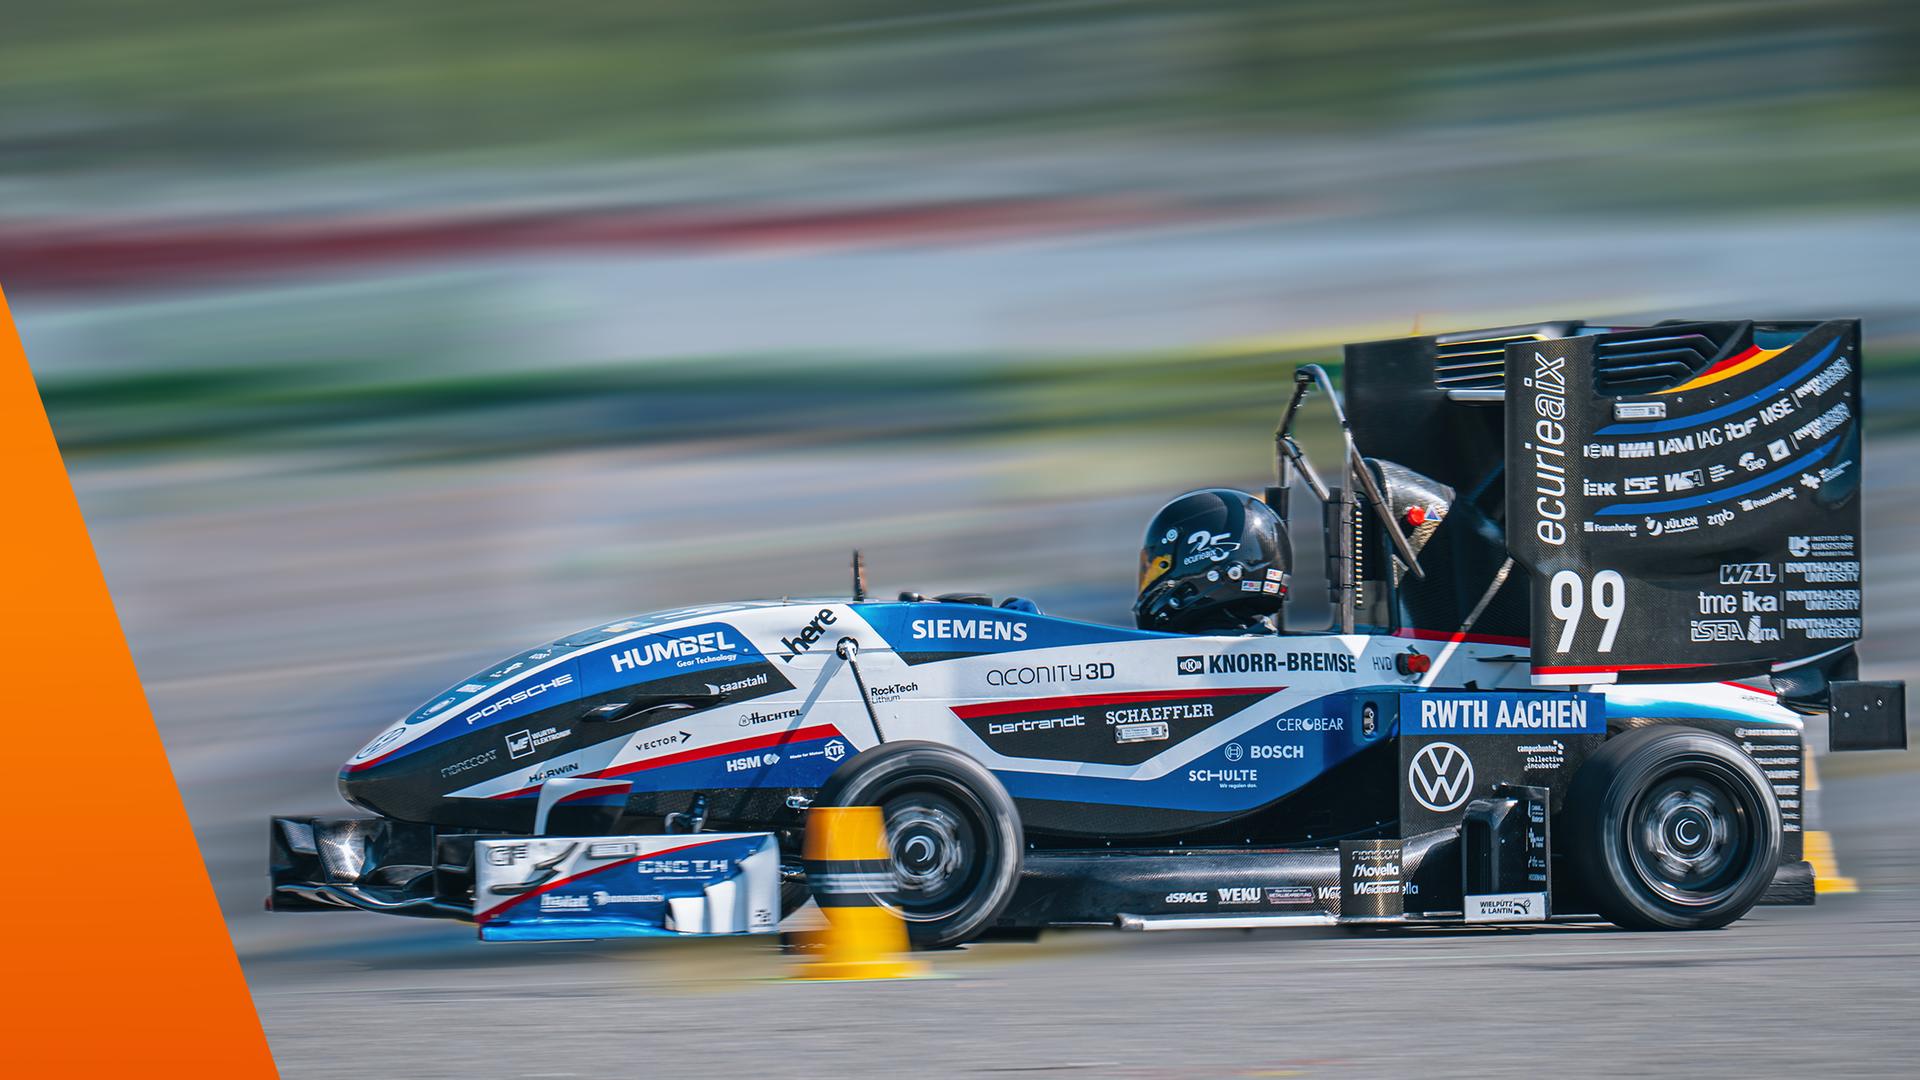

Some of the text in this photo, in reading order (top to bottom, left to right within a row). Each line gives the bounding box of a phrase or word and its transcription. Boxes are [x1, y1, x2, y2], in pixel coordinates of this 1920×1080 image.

[1759, 397, 1795, 425] MSE
[1696, 427, 1723, 449] IAC
[1524, 351, 1566, 546] ecurieaix
[1594, 522, 1637, 532] Fraunhofer
[1719, 562, 1777, 585] WZL
[1742, 590, 1778, 612] ika
[1550, 569, 1626, 654] 99
[781, 608, 838, 656] here
[911, 619, 1028, 642] SIEMENS
[610, 631, 736, 673] HUMBEL
[676, 653, 737, 668] Gear Technology
[1209, 652, 1357, 674] KNORR-BREMSE
[1373, 656, 1393, 671] HVD
[720, 673, 768, 693] saarstahl
[870, 682, 919, 697] RockTech
[466, 673, 574, 725] PORSCHE
[871, 693, 901, 704] Lithium
[1105, 703, 1214, 725] SCHAEFFLER
[1421, 700, 1587, 728] RWTH AACHEN
[989, 714, 1086, 735] bertrandt
[636, 735, 677, 751] VECTOR
[824, 745, 846, 757] KTR
[1250, 745, 1304, 759] BOSCH
[529, 763, 579, 783] HARWIN
[726, 755, 761, 773] HSM
[1188, 769, 1258, 782] SCHULTE
[638, 861, 688, 873] CNC
[1165, 891, 1208, 904] dSPACE
[1217, 887, 1261, 901] WEKU
